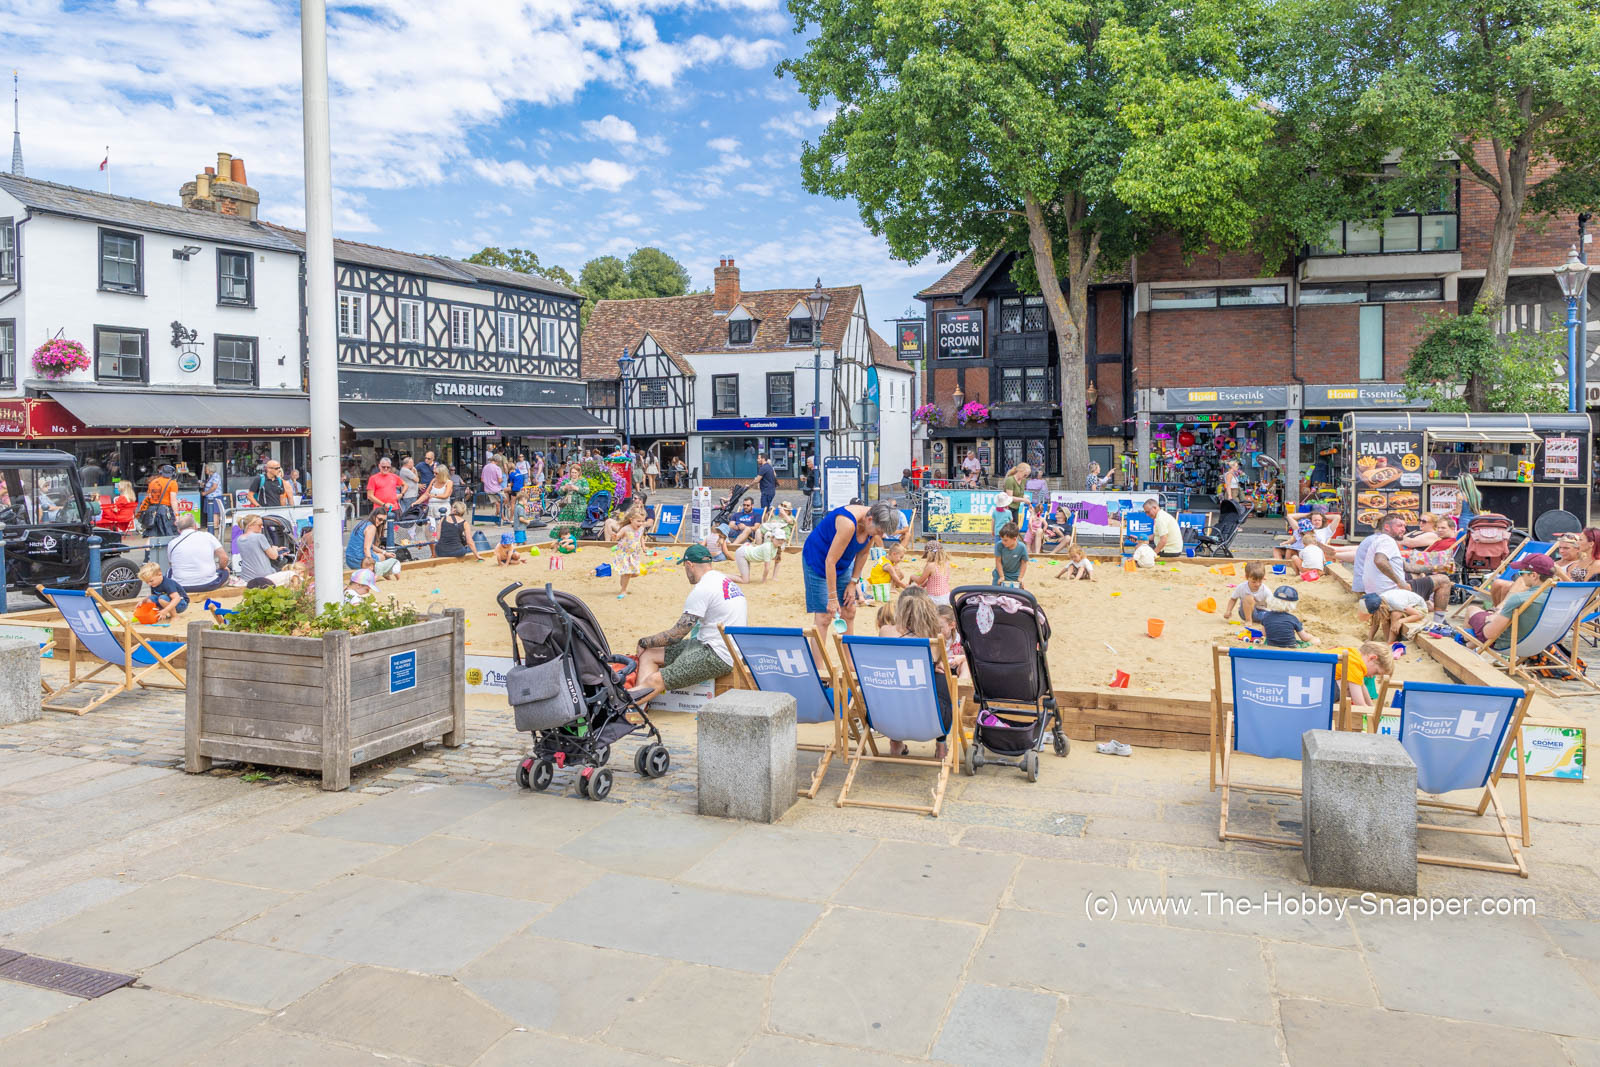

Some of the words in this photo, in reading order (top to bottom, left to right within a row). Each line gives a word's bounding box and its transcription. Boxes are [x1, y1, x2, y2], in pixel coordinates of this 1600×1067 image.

[941, 323, 969, 334] ROSE
[971, 322, 979, 333] &
[940, 336, 980, 347] CROWN
[434, 382, 504, 397] STARBUCKS
[1329, 389, 1357, 399] HOME
[1189, 392, 1217, 401] HOME
[1361, 442, 1413, 455] FALAFEL
[1405, 459, 1416, 467] £8
[496, 672, 507, 680] Bro
[567, 678, 578, 704] Oyster
[1532, 740, 1563, 748] CROMER
